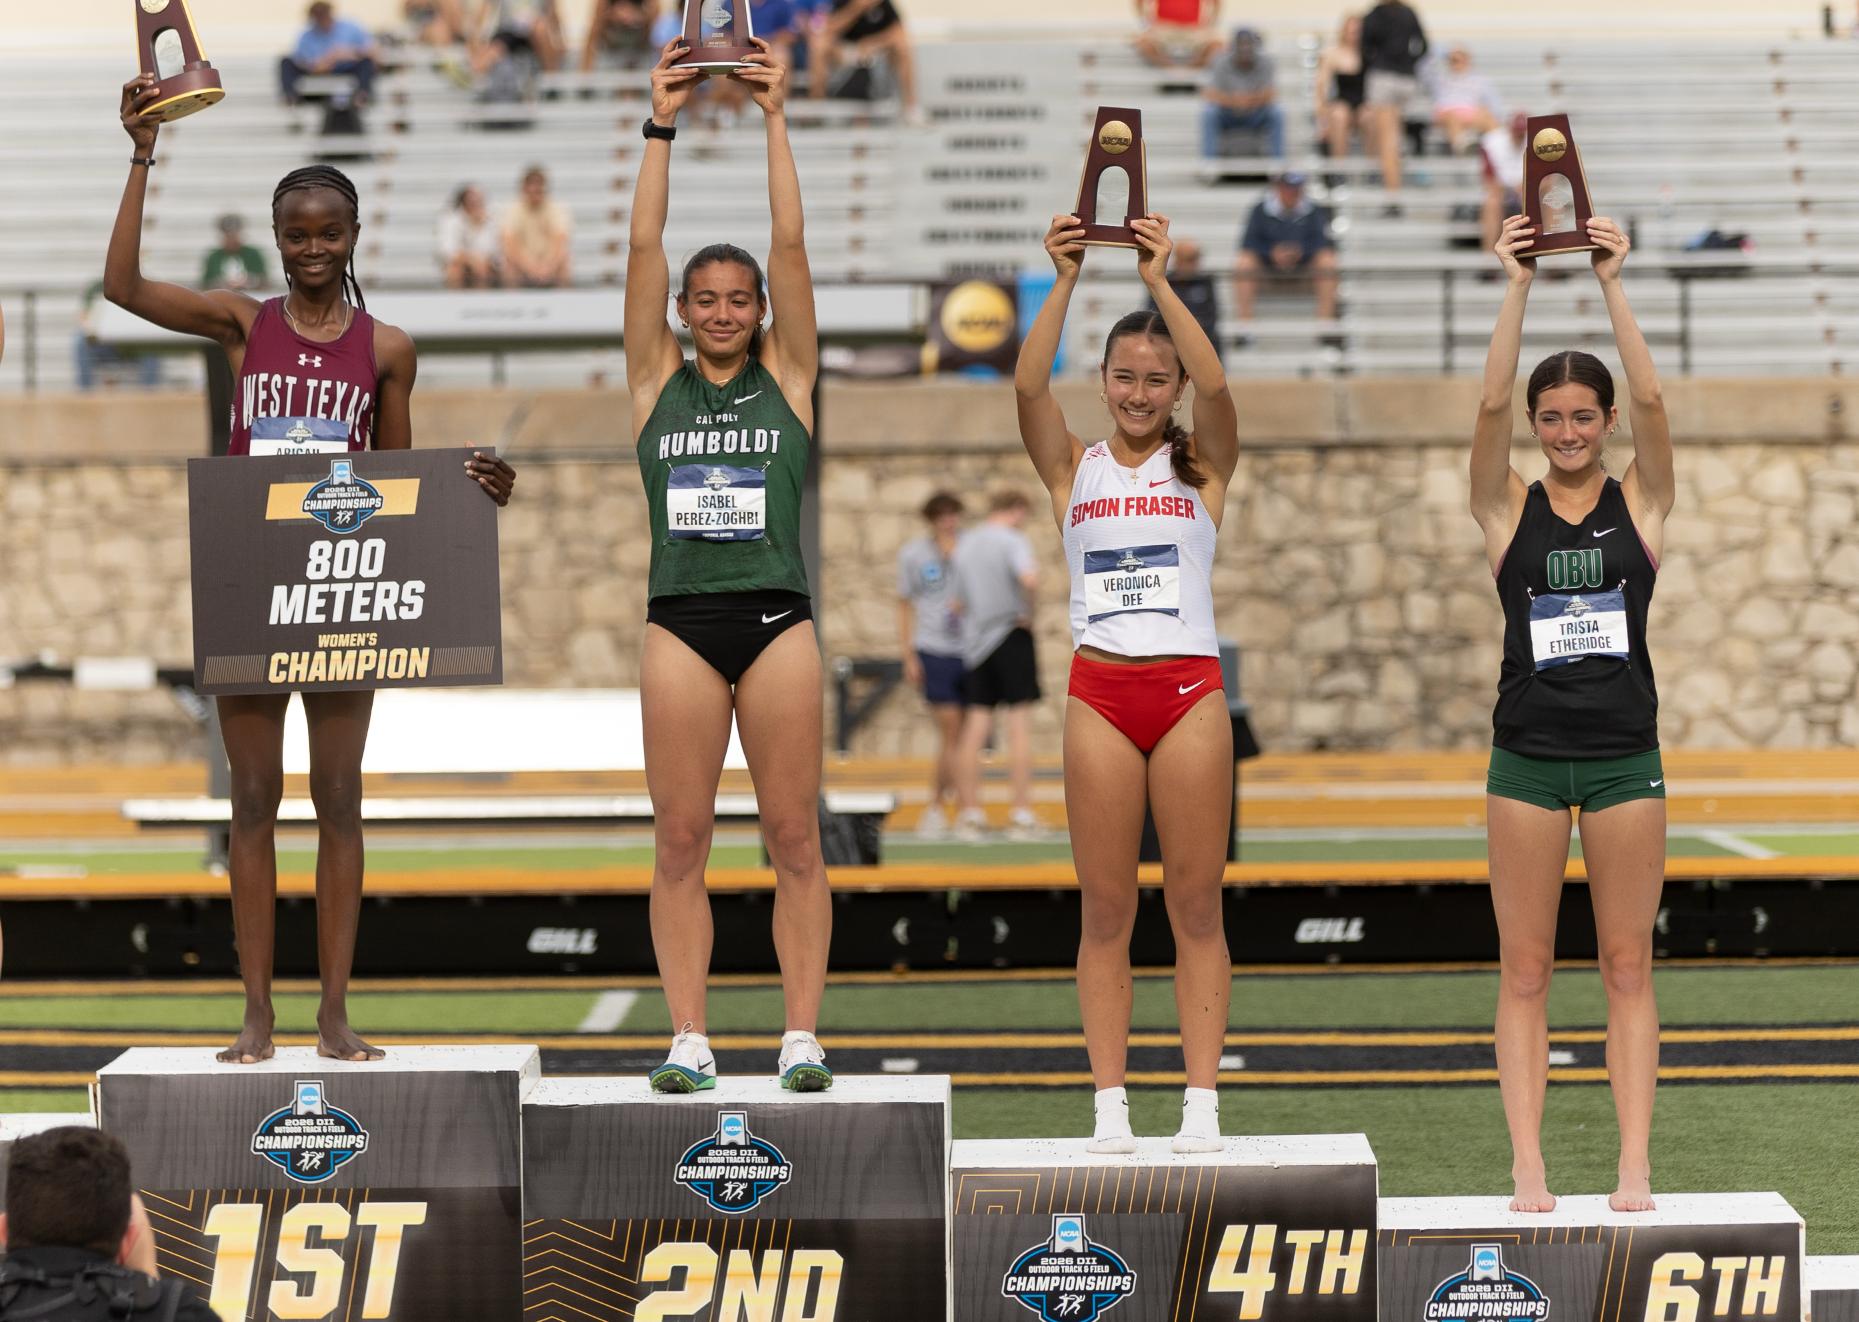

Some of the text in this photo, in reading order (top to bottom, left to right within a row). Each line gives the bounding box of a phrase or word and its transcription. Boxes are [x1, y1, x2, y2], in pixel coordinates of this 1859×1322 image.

[1101, 135, 1130, 146] NCAA
[1536, 141, 1566, 155] NCAA
[243, 372, 297, 430] WEST
[696, 413, 739, 425] CAL POLY
[658, 428, 781, 460] HUMBOLDT
[303, 497, 382, 511] CHAMPIONSHIPS
[697, 495, 737, 508] ISABEL
[676, 511, 758, 526] PEREZ-ZOGHBI
[1071, 496, 1196, 528] SIMON FRASER
[305, 538, 386, 580] 800
[1547, 548, 1603, 590] OBU
[1103, 574, 1161, 592] VERONICA
[268, 580, 426, 625] METERS
[1122, 592, 1143, 607] DEE
[1559, 620, 1600, 636] TRISTA
[318, 632, 378, 648] WOMEN'S
[1549, 636, 1612, 654] ETHERIDGE
[268, 646, 430, 684] CHAMPION
[1294, 916, 1365, 943] GILL
[526, 926, 598, 954] GILL
[284, 1118, 314, 1126] 2026
[328, 1125, 346, 1133] FIELD
[255, 1135, 365, 1149] CHAMPIONSHIPS
[678, 1165, 788, 1179] CHAMPIONSHIPS
[203, 1202, 428, 1322] 1ST
[1028, 1265, 1110, 1273] OUTDOOR TRACK & FIELD
[1040, 1257, 1097, 1265] 2026 DII
[1207, 1224, 1368, 1320] 4TH
[633, 1242, 844, 1322] 2ND
[1006, 1275, 1132, 1291] CHAMPIONSHIPS
[1494, 1284, 1513, 1292] DII
[1644, 1252, 1786, 1322] 6TH
[1449, 1292, 1525, 1300] OUTDOOR TRACK & FIELD
[1428, 1301, 1546, 1318] CHAMPIONSHIPS
